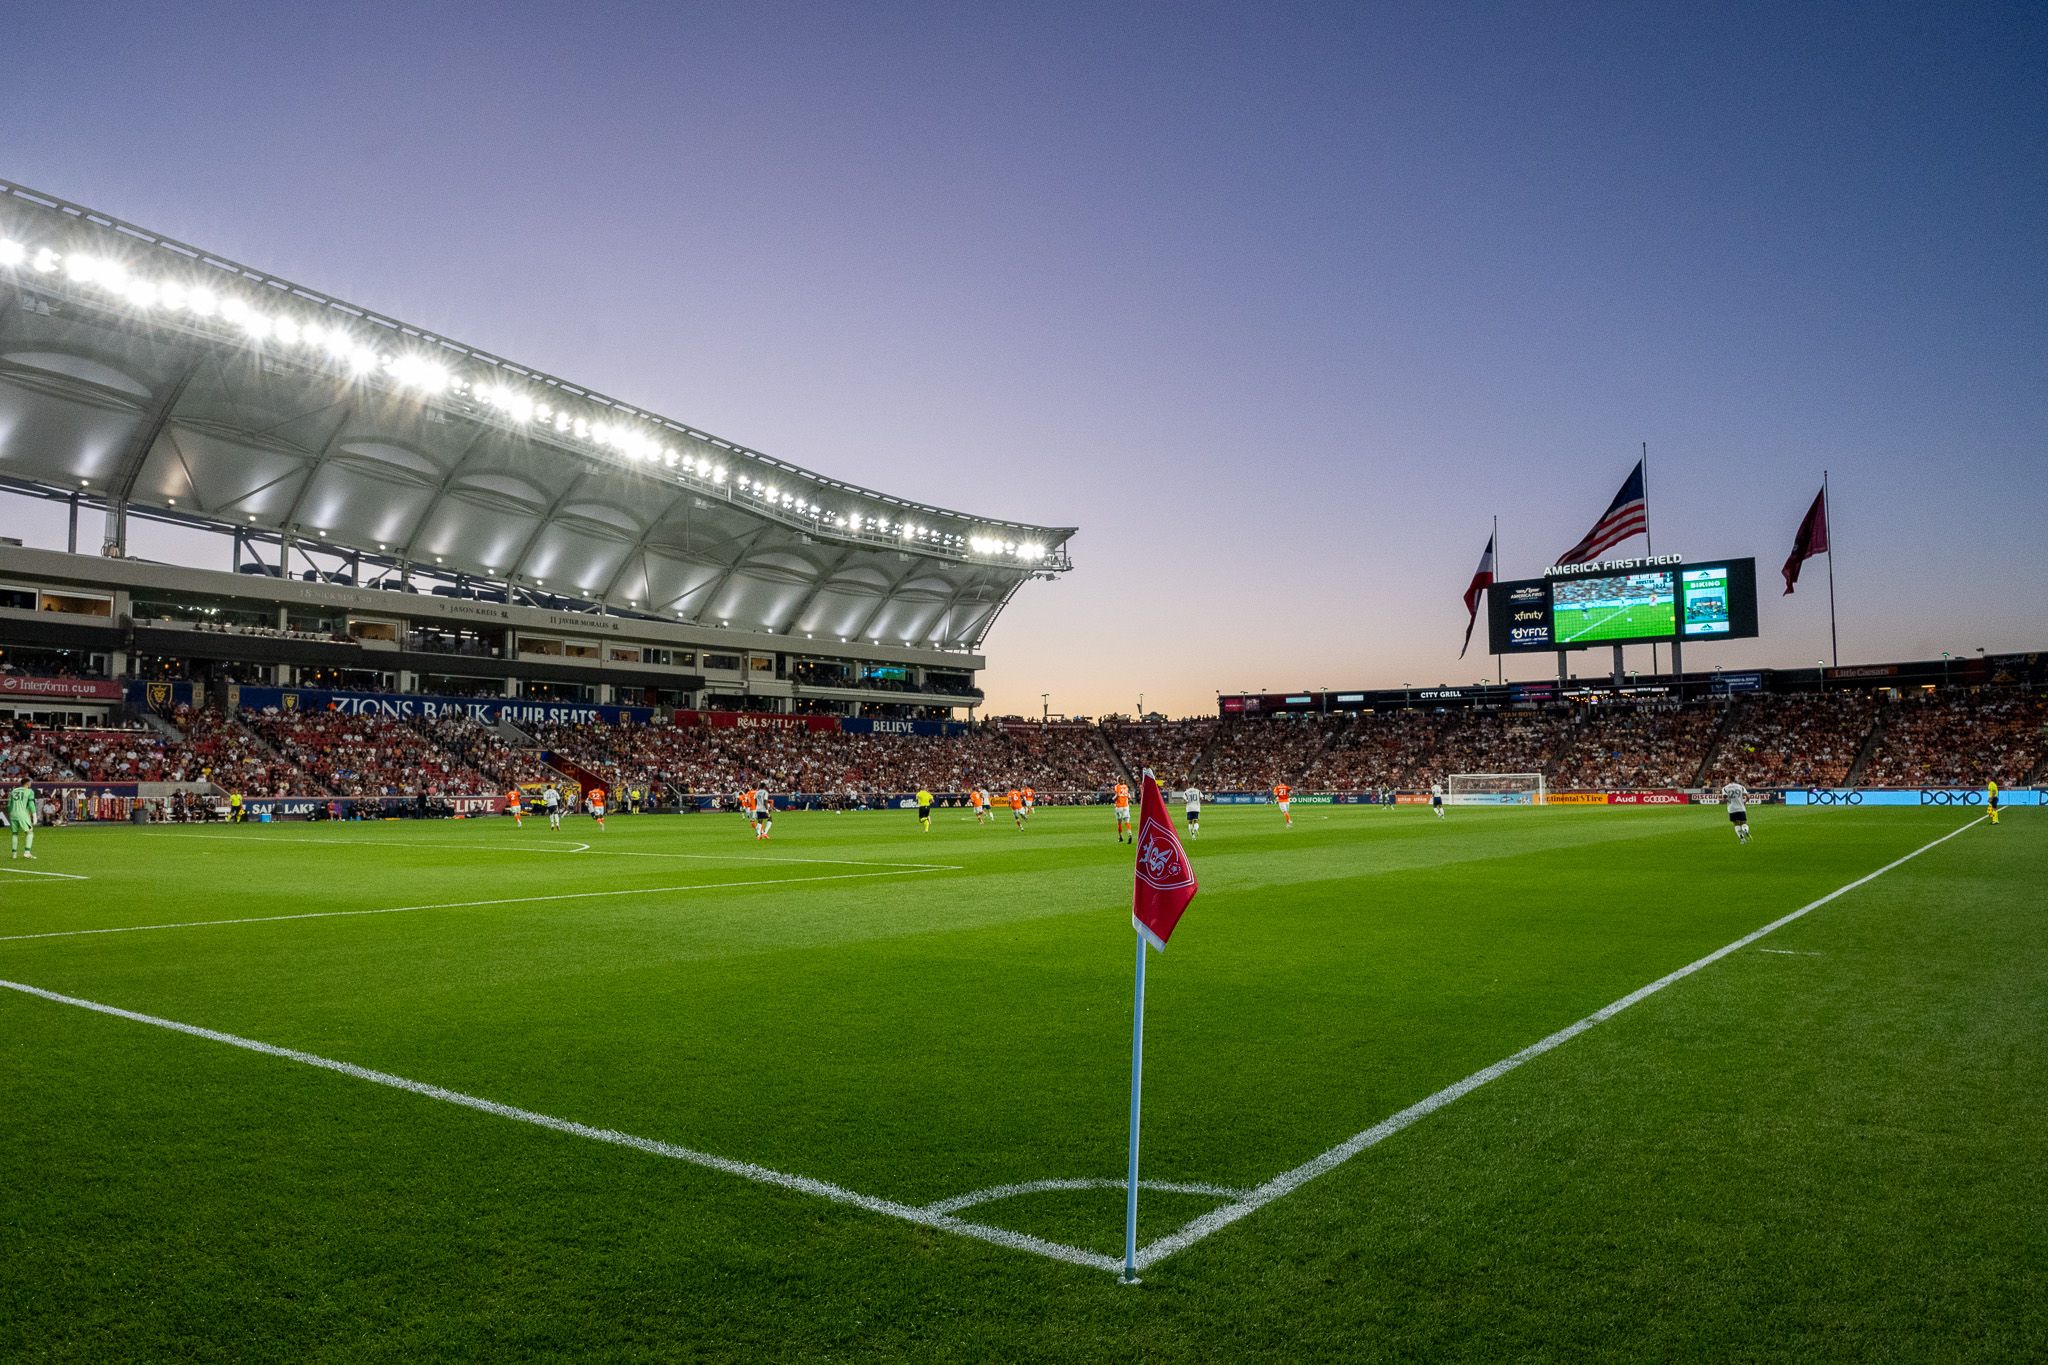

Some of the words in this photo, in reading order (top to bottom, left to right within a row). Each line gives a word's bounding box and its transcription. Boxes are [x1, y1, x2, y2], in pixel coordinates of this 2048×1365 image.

[1544, 561, 1601, 576] AMERICA
[1603, 558, 1642, 570] FIRST
[1646, 553, 1682, 566] FIELD
[1690, 580, 1721, 589] BIKING
[439, 604, 445, 612] 9
[450, 605, 474, 615] JASON
[1514, 610, 1543, 621] xfinity
[558, 617, 580, 626] JAVIER
[20, 679, 68, 693] Interform
[71, 684, 96, 693] CLUB
[1439, 690, 1462, 698] GRILL
[332, 697, 413, 721] ZIONS
[873, 720, 914, 733] BELIEVE
[13, 791, 24, 801] 31
[1189, 793, 1197, 802] 10
[1585, 794, 1602, 802] Tire
[1728, 789, 1741, 799] 29
[1807, 791, 1863, 805] DOMO
[1921, 791, 1982, 805] DOMO
